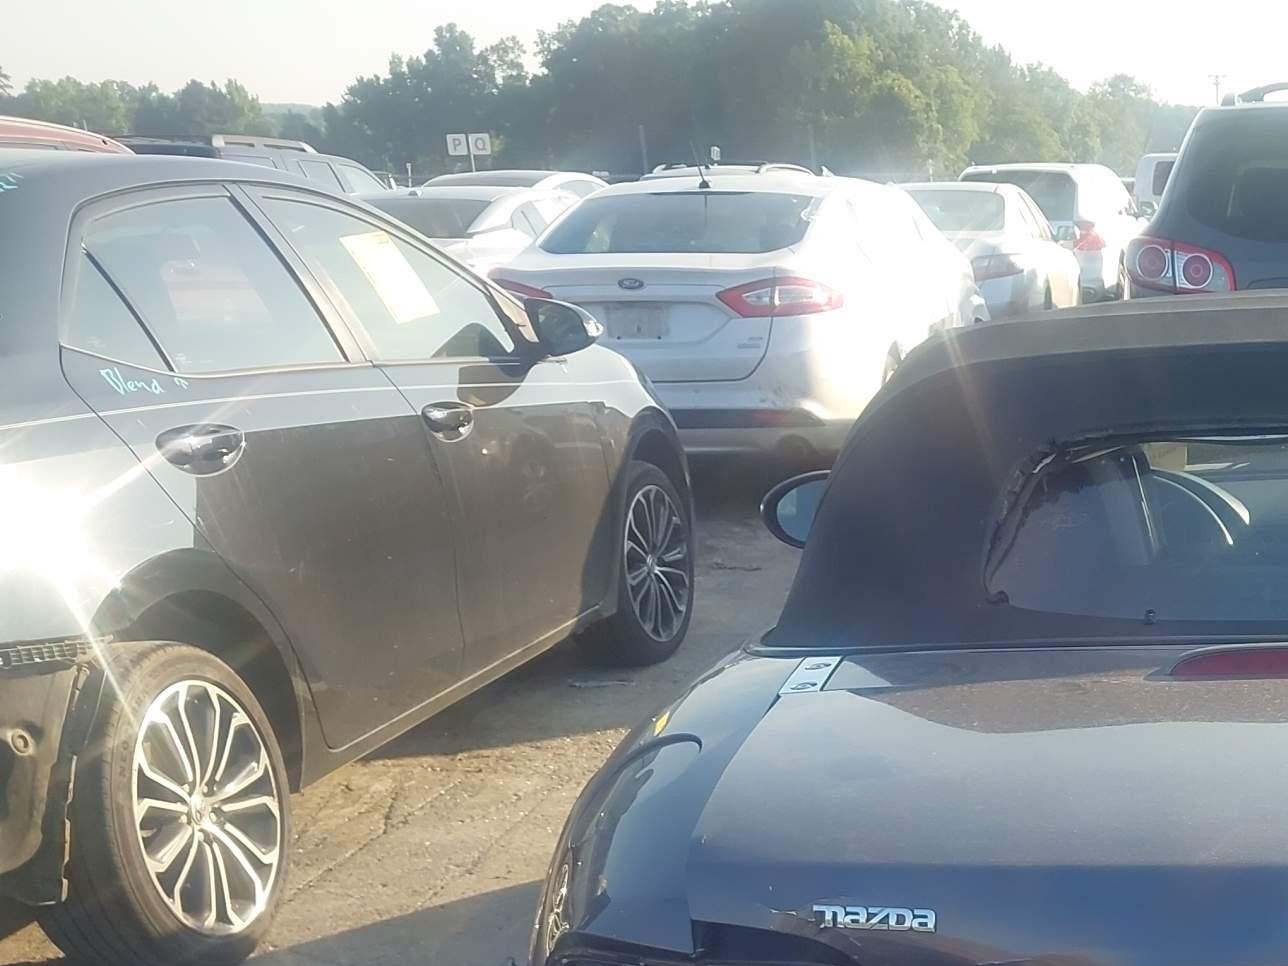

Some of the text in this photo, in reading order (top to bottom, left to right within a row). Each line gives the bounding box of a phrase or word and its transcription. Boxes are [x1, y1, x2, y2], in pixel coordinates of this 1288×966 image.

[452, 138, 462, 153] P
[474, 136, 488, 152] Q
[99, 367, 166, 395] Blend
